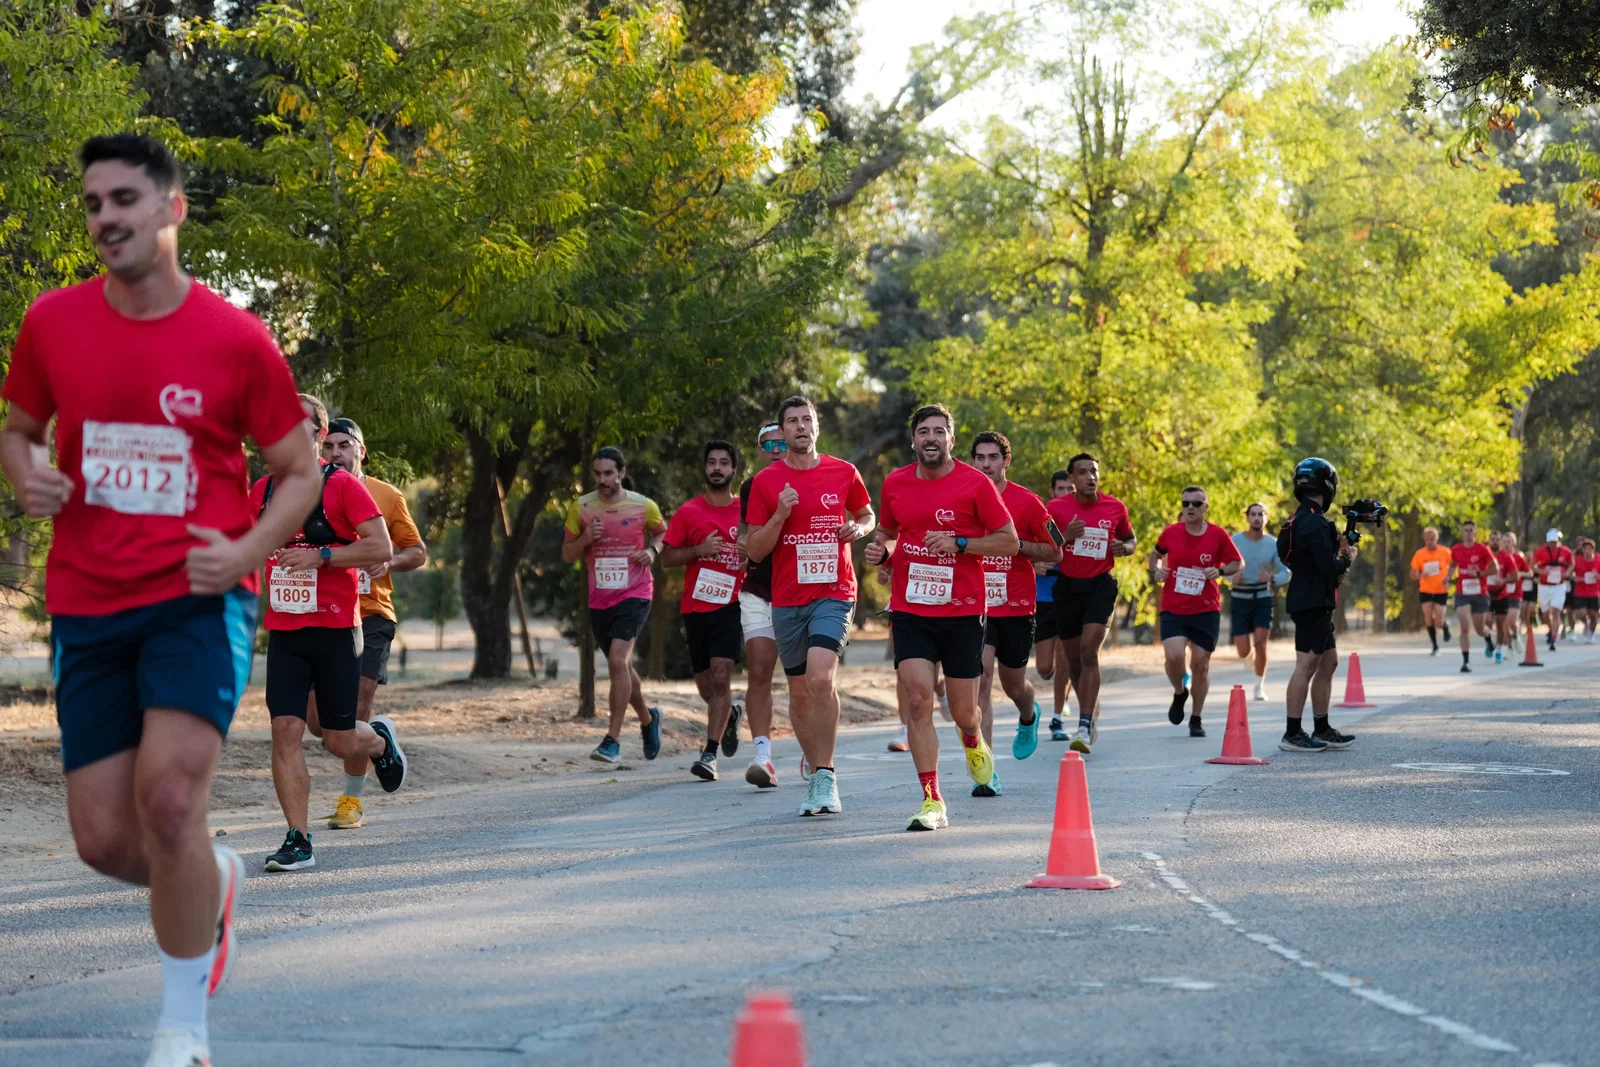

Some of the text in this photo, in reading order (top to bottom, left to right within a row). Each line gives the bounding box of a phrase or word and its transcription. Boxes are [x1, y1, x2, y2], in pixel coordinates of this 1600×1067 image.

[94, 461, 172, 495] 2012
[1081, 539, 1101, 551] 994
[938, 557, 956, 565] 2026
[802, 561, 835, 575] 1876
[599, 571, 625, 582] 1617
[698, 583, 728, 598] 2038
[913, 581, 947, 597] 1189
[1181, 579, 1199, 590] 444
[275, 588, 311, 603] 1809
[987, 588, 1003, 599] 04
